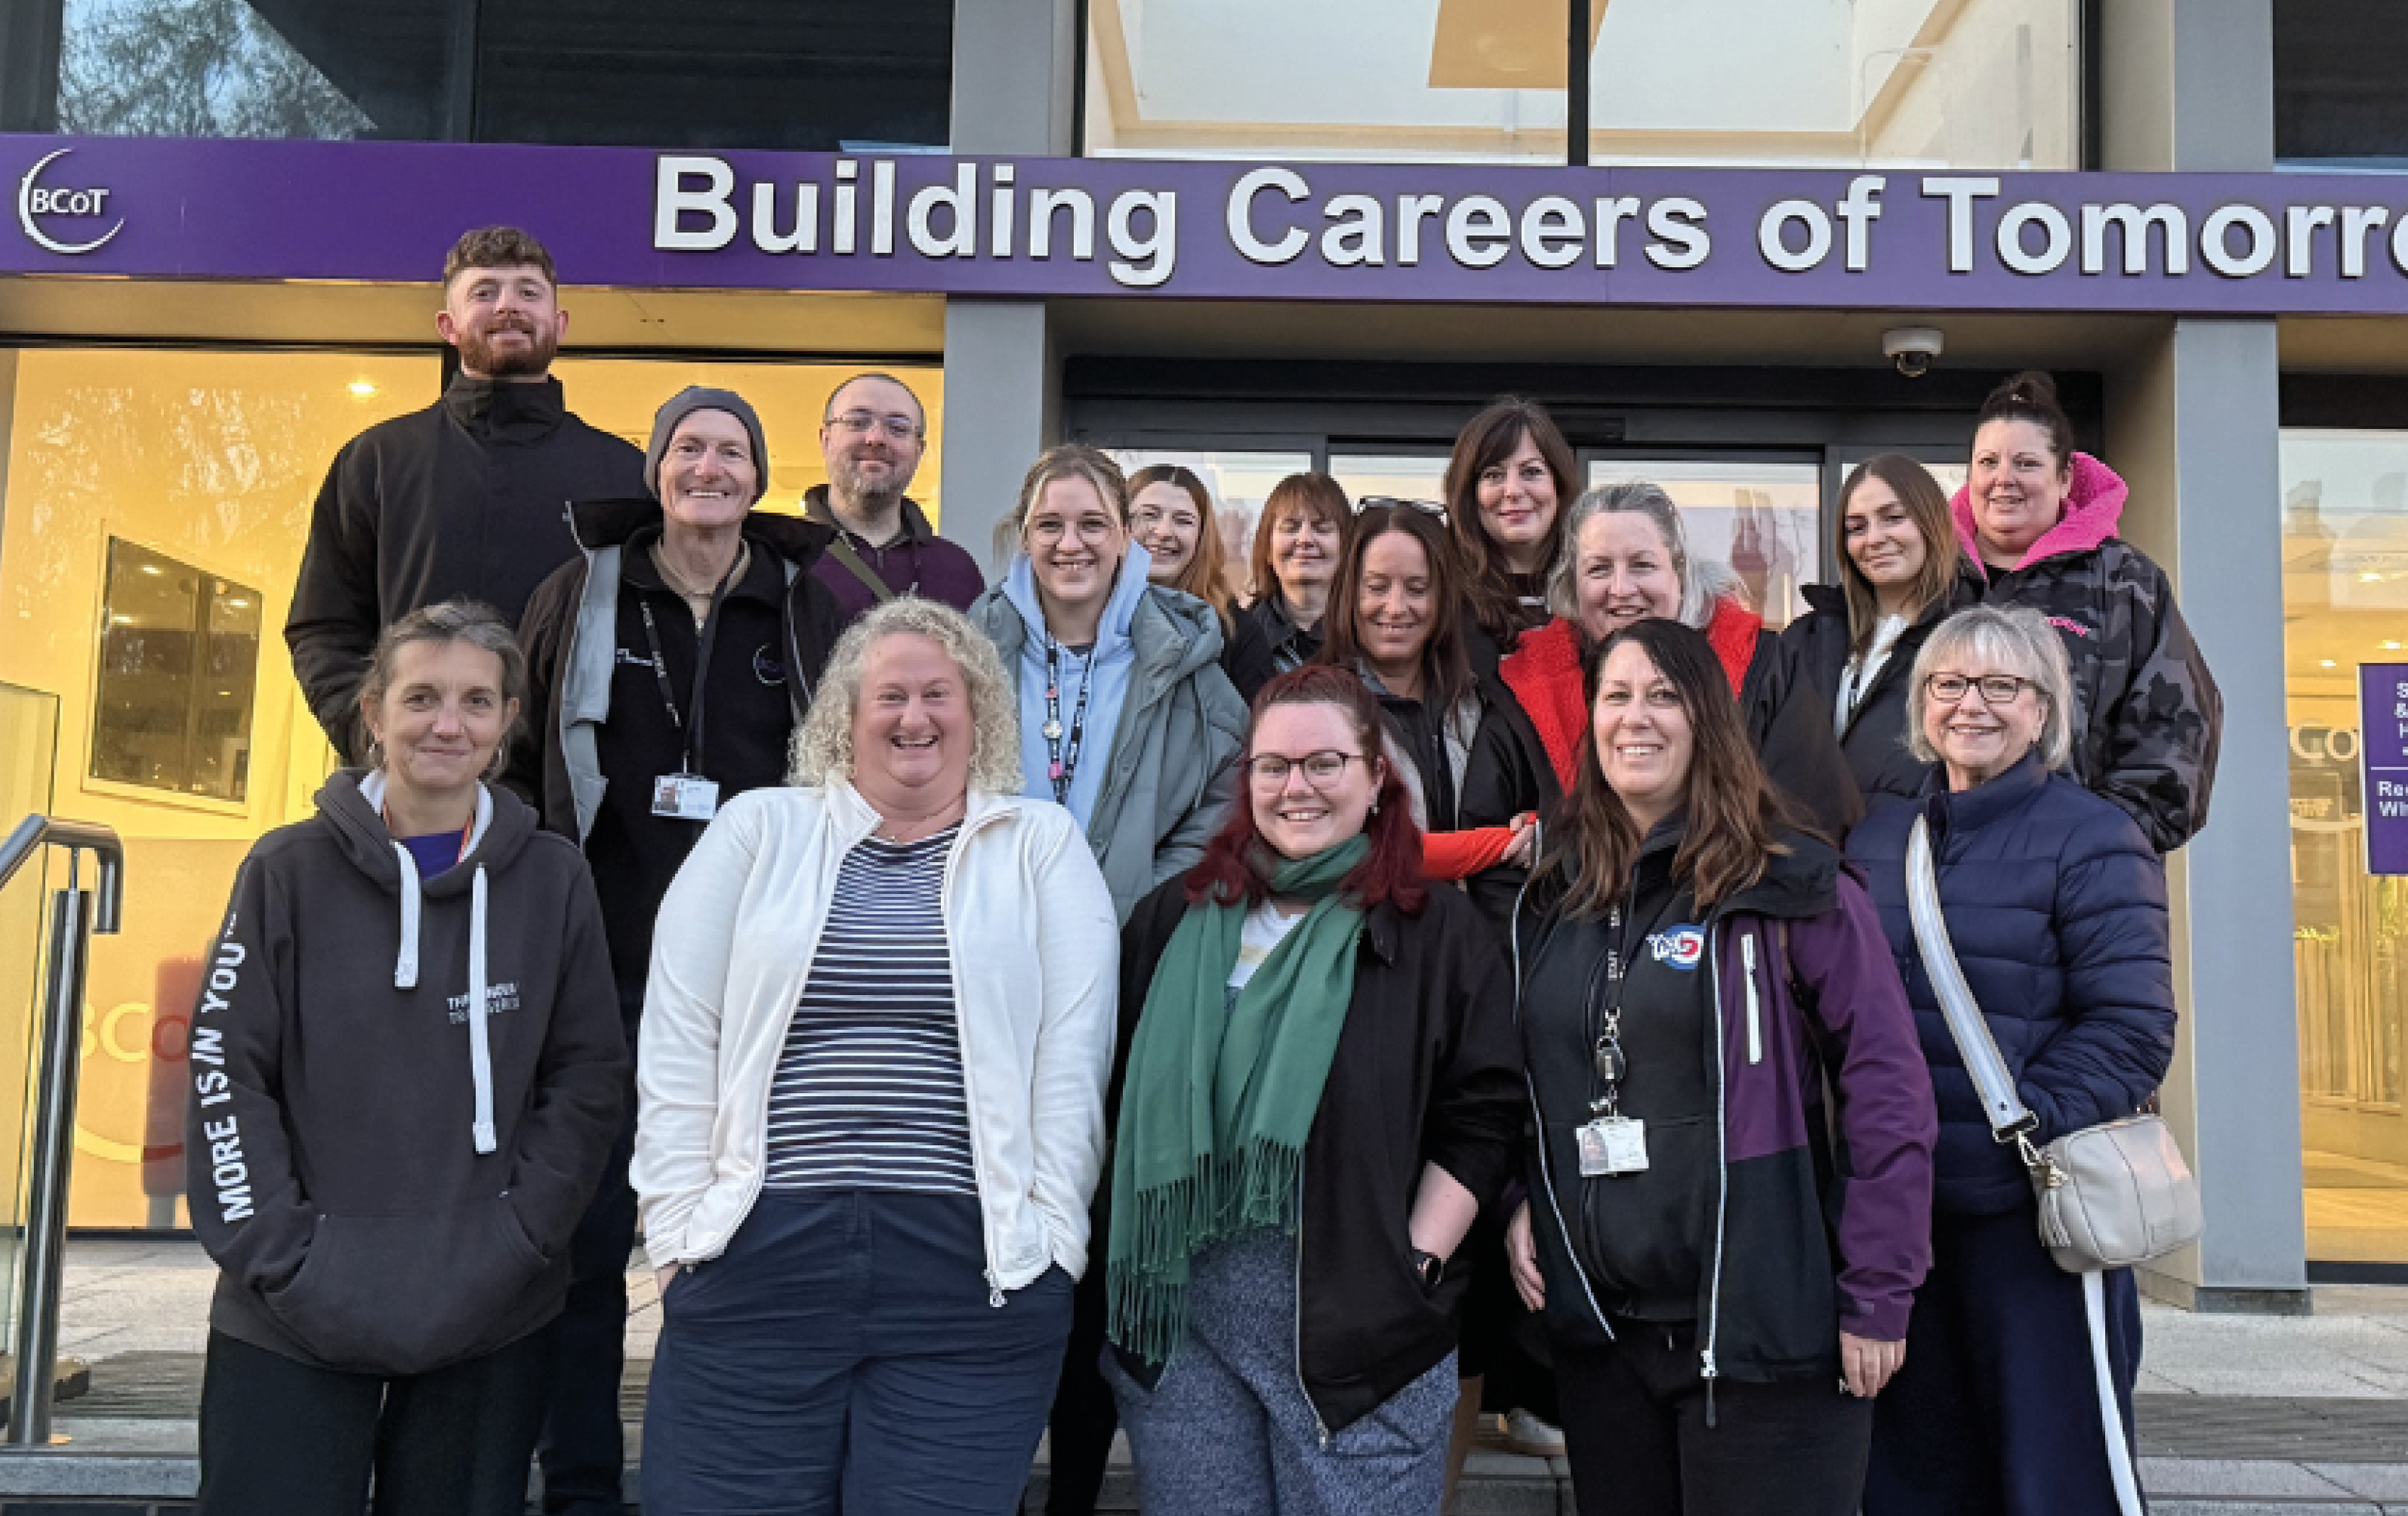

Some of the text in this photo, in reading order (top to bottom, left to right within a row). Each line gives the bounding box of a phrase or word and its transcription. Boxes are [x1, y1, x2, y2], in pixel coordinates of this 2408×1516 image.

[30, 189, 110, 216] BCoT
[655, 155, 2408, 288] Building Careers of Tomorr
[189, 1026, 225, 1065] IN
[196, 1070, 232, 1108] IS
[205, 1114, 254, 1224] MORE
